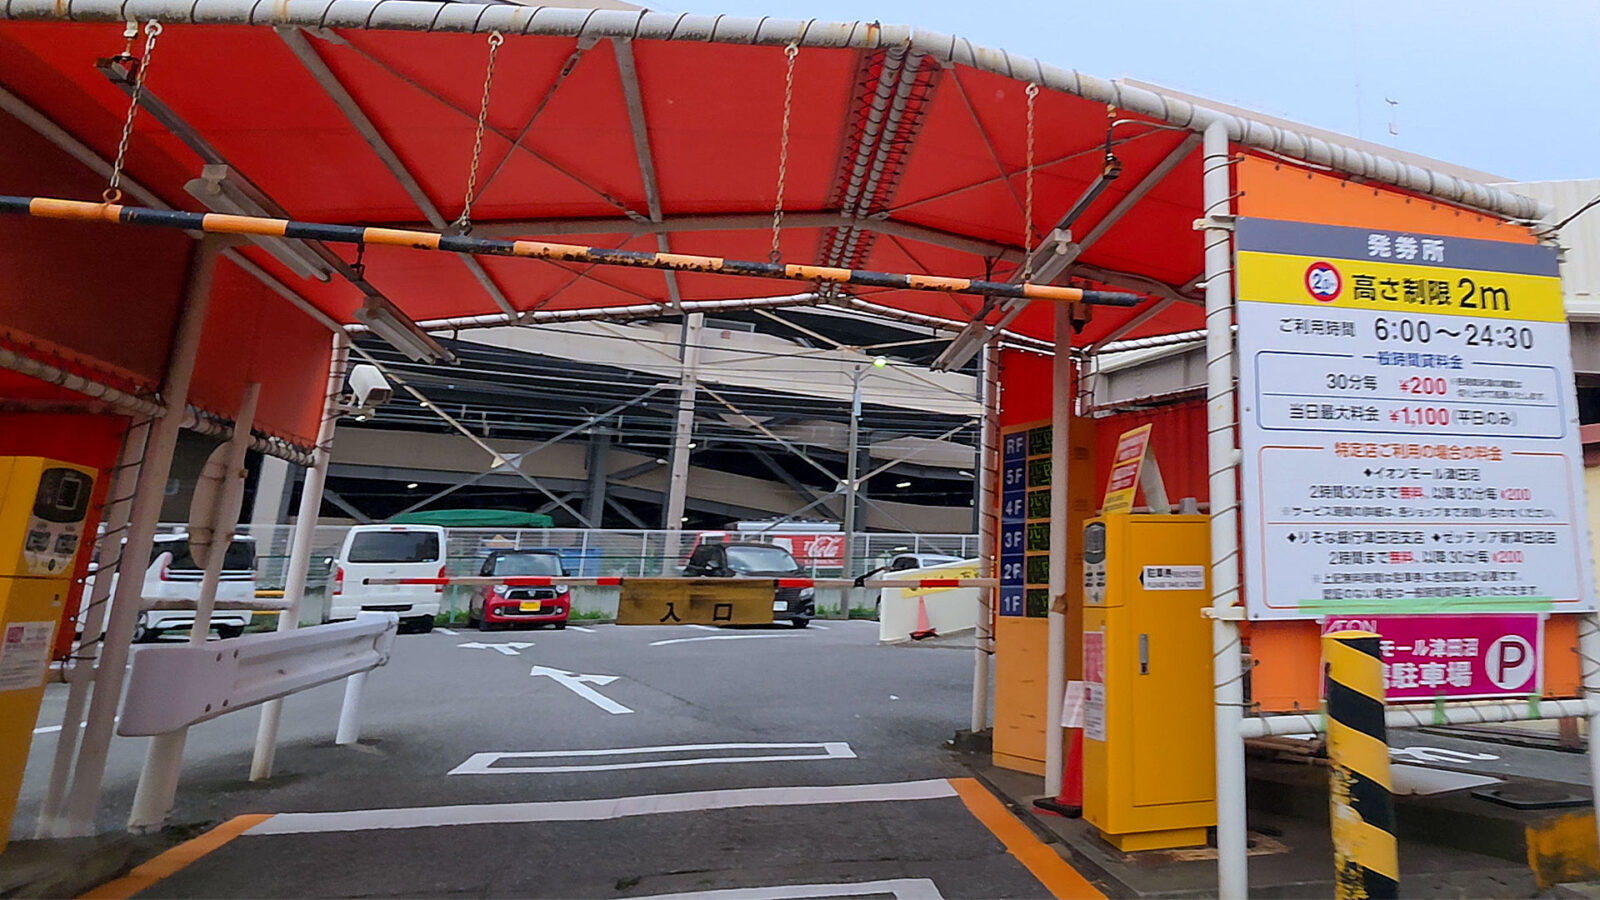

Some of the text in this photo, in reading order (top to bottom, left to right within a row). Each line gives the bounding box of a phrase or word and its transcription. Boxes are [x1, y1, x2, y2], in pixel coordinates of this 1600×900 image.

[1367, 233, 1445, 262] 発券所
[1279, 318, 1356, 338] ご利用時間
[1327, 373, 1378, 392] 30分毎
[1400, 377, 1448, 396] ¥200
[1290, 403, 1380, 422] 当日最大料金
[1389, 407, 1450, 427] ¥1,100
[1006, 437, 1024, 454] RF
[1006, 467, 1023, 485] 5F
[1005, 499, 1023, 516] 4F
[1004, 531, 1022, 548] 3F
[1004, 563, 1021, 580] 2F
[659, 602, 733, 622] 入口
[1004, 595, 1020, 612] 1F
[1498, 641, 1526, 684] P
